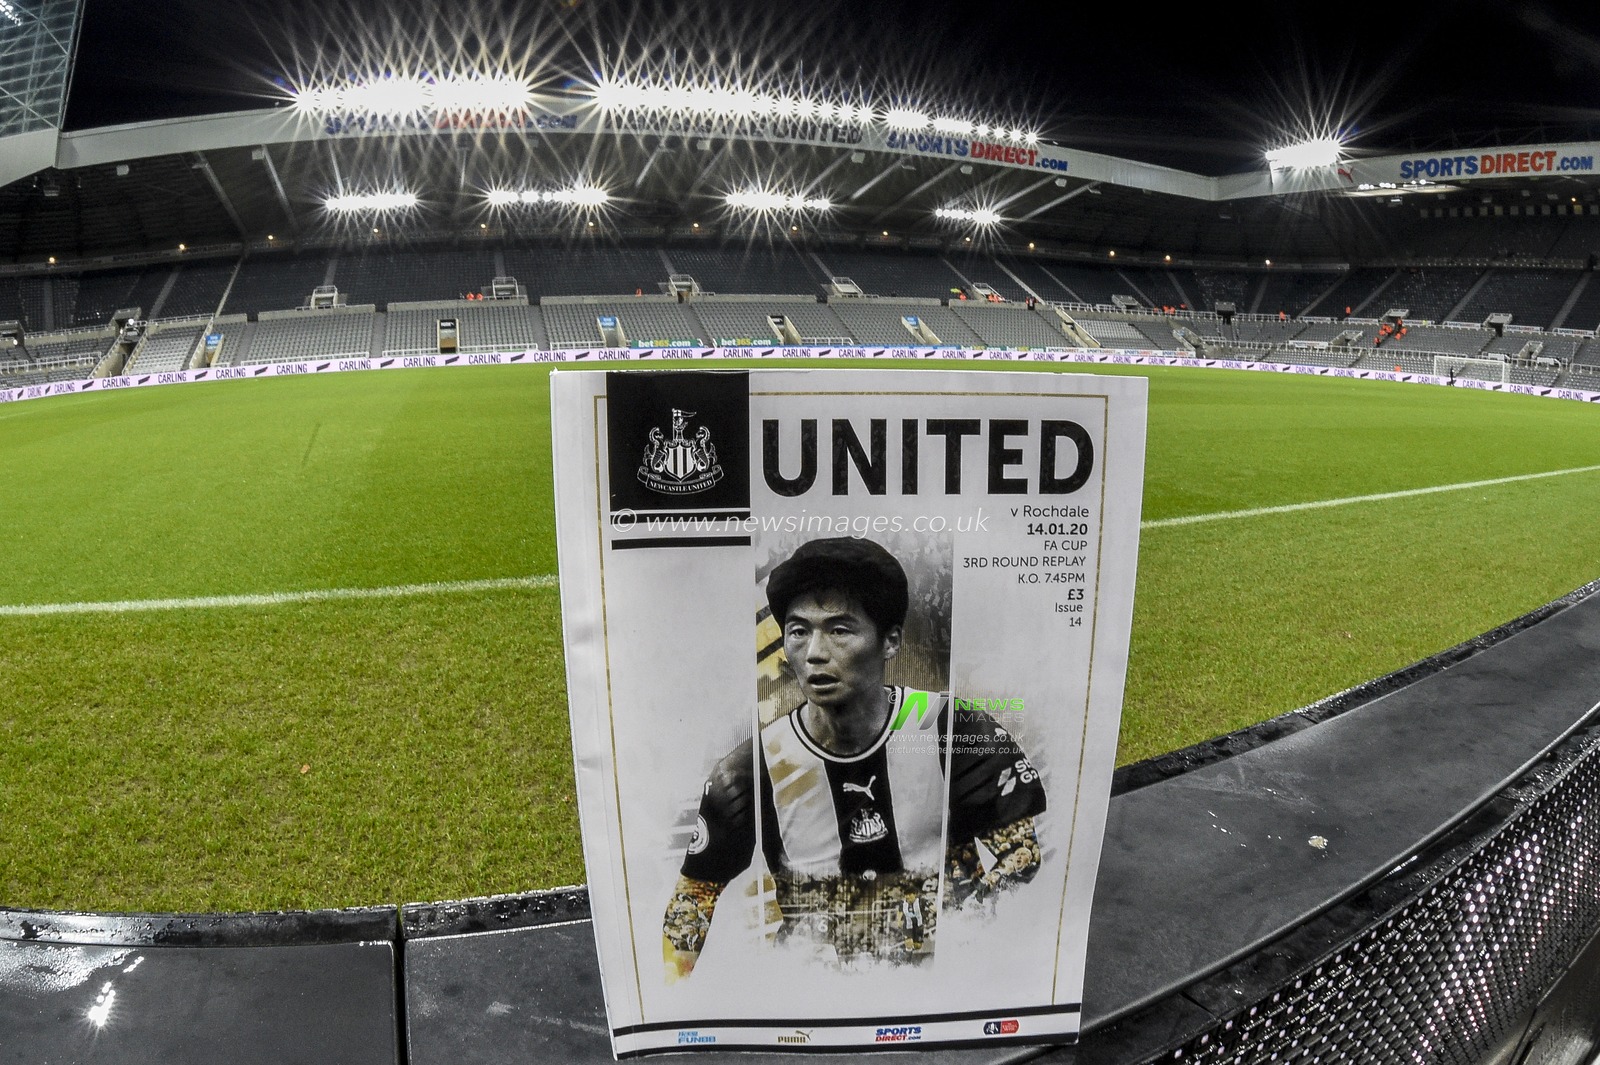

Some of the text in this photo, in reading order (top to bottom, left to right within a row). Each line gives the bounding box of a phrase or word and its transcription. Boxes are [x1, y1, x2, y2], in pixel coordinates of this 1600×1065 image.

[534, 352, 566, 362] CARLING
[599, 350, 630, 360] CARLING
[662, 350, 693, 359] CARLING
[723, 349, 753, 358] CARLING
[782, 348, 811, 358] CARLING
[839, 348, 866, 358] CARLING
[892, 349, 917, 358] CARLING
[942, 349, 966, 358] CARLING
[989, 350, 1012, 360] CARLING
[1033, 352, 1054, 361] CARLING
[1075, 353, 1094, 363] CARLING
[404, 356, 436, 367] CARLING
[468, 354, 501, 364] CARLING
[1113, 354, 1131, 364] CARLING
[1148, 356, 1165, 365] CARLING
[1182, 358, 1200, 367] CARLING
[277, 364, 307, 374] CARLING
[339, 360, 371, 371] CARLING
[1222, 360, 1242, 369] CARLING
[1259, 362, 1277, 372] CARLING
[1296, 365, 1315, 374] CARLING
[158, 372, 186, 383] CARLING
[216, 368, 246, 378] CARLING
[1334, 368, 1354, 377] CARLING
[1375, 372, 1396, 381] CARLING
[102, 377, 130, 389] CARLING
[1418, 375, 1440, 385] CARLING
[1463, 380, 1486, 389] CARLING
[55, 382, 75, 393] CARLING
[1510, 384, 1534, 395] CARLING
[1558, 390, 1583, 400] CARLING
[762, 418, 1095, 497] UNITED
[649, 479, 713, 492] NEWCASTLE UNITED
[1010, 505, 1090, 518] v Rochdale
[1027, 523, 1088, 535] 14.01.20
[1044, 540, 1088, 551] FA CUP
[963, 556, 1087, 568] 3RD ROUND REPLAY
[1018, 573, 1085, 584] K.O. 7.45PM
[1067, 588, 1084, 600] £3
[1055, 602, 1083, 613] Issue
[1069, 617, 1082, 627] 14
[875, 1026, 922, 1036] SPORTS
